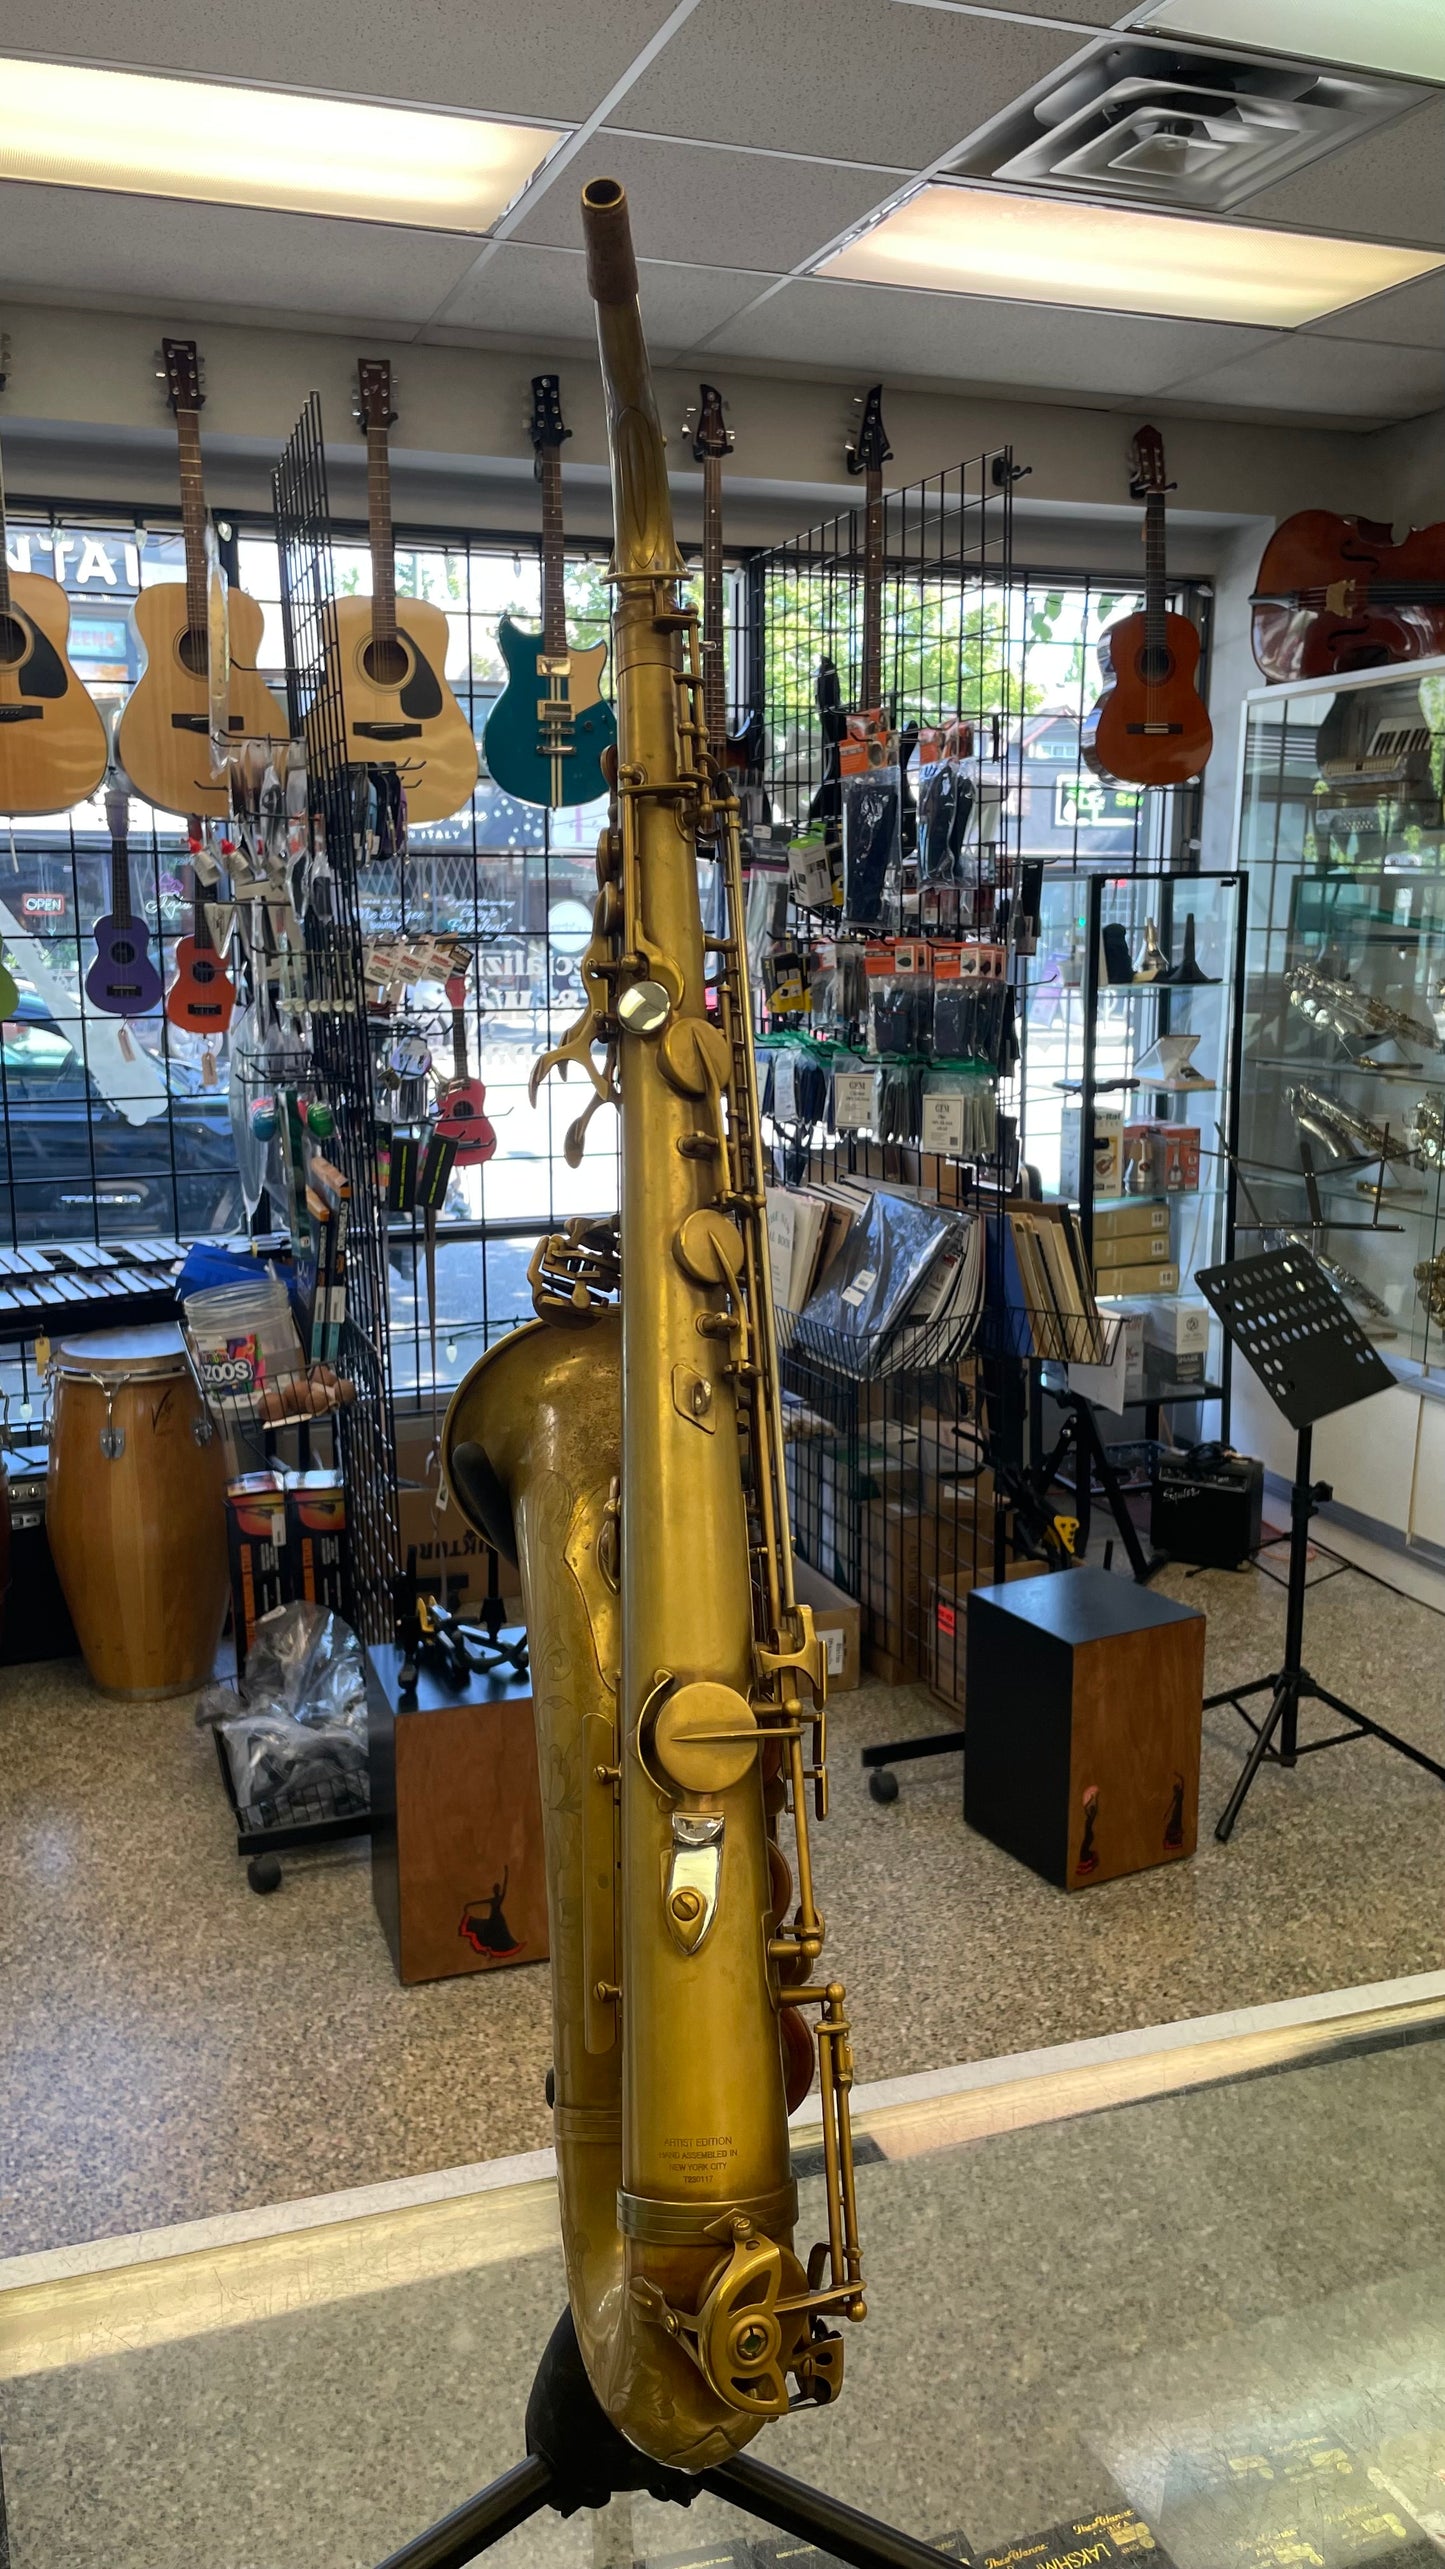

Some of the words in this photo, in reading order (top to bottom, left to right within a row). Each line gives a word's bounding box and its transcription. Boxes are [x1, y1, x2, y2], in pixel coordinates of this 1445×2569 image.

[421, 829, 461, 840] ITALY
[25, 897, 62, 912] OPEN
[664, 2137, 693, 2148] ARTIST
[695, 2136, 733, 2147] EDITION
[659, 2152, 680, 2160] HAND
[681, 2150, 728, 2159] ASSEMBLED
[729, 2149, 738, 2157] IN
[669, 2164, 686, 2172] NEW
[687, 2163, 708, 2172] YORK
[710, 2161, 727, 2171] CITY
